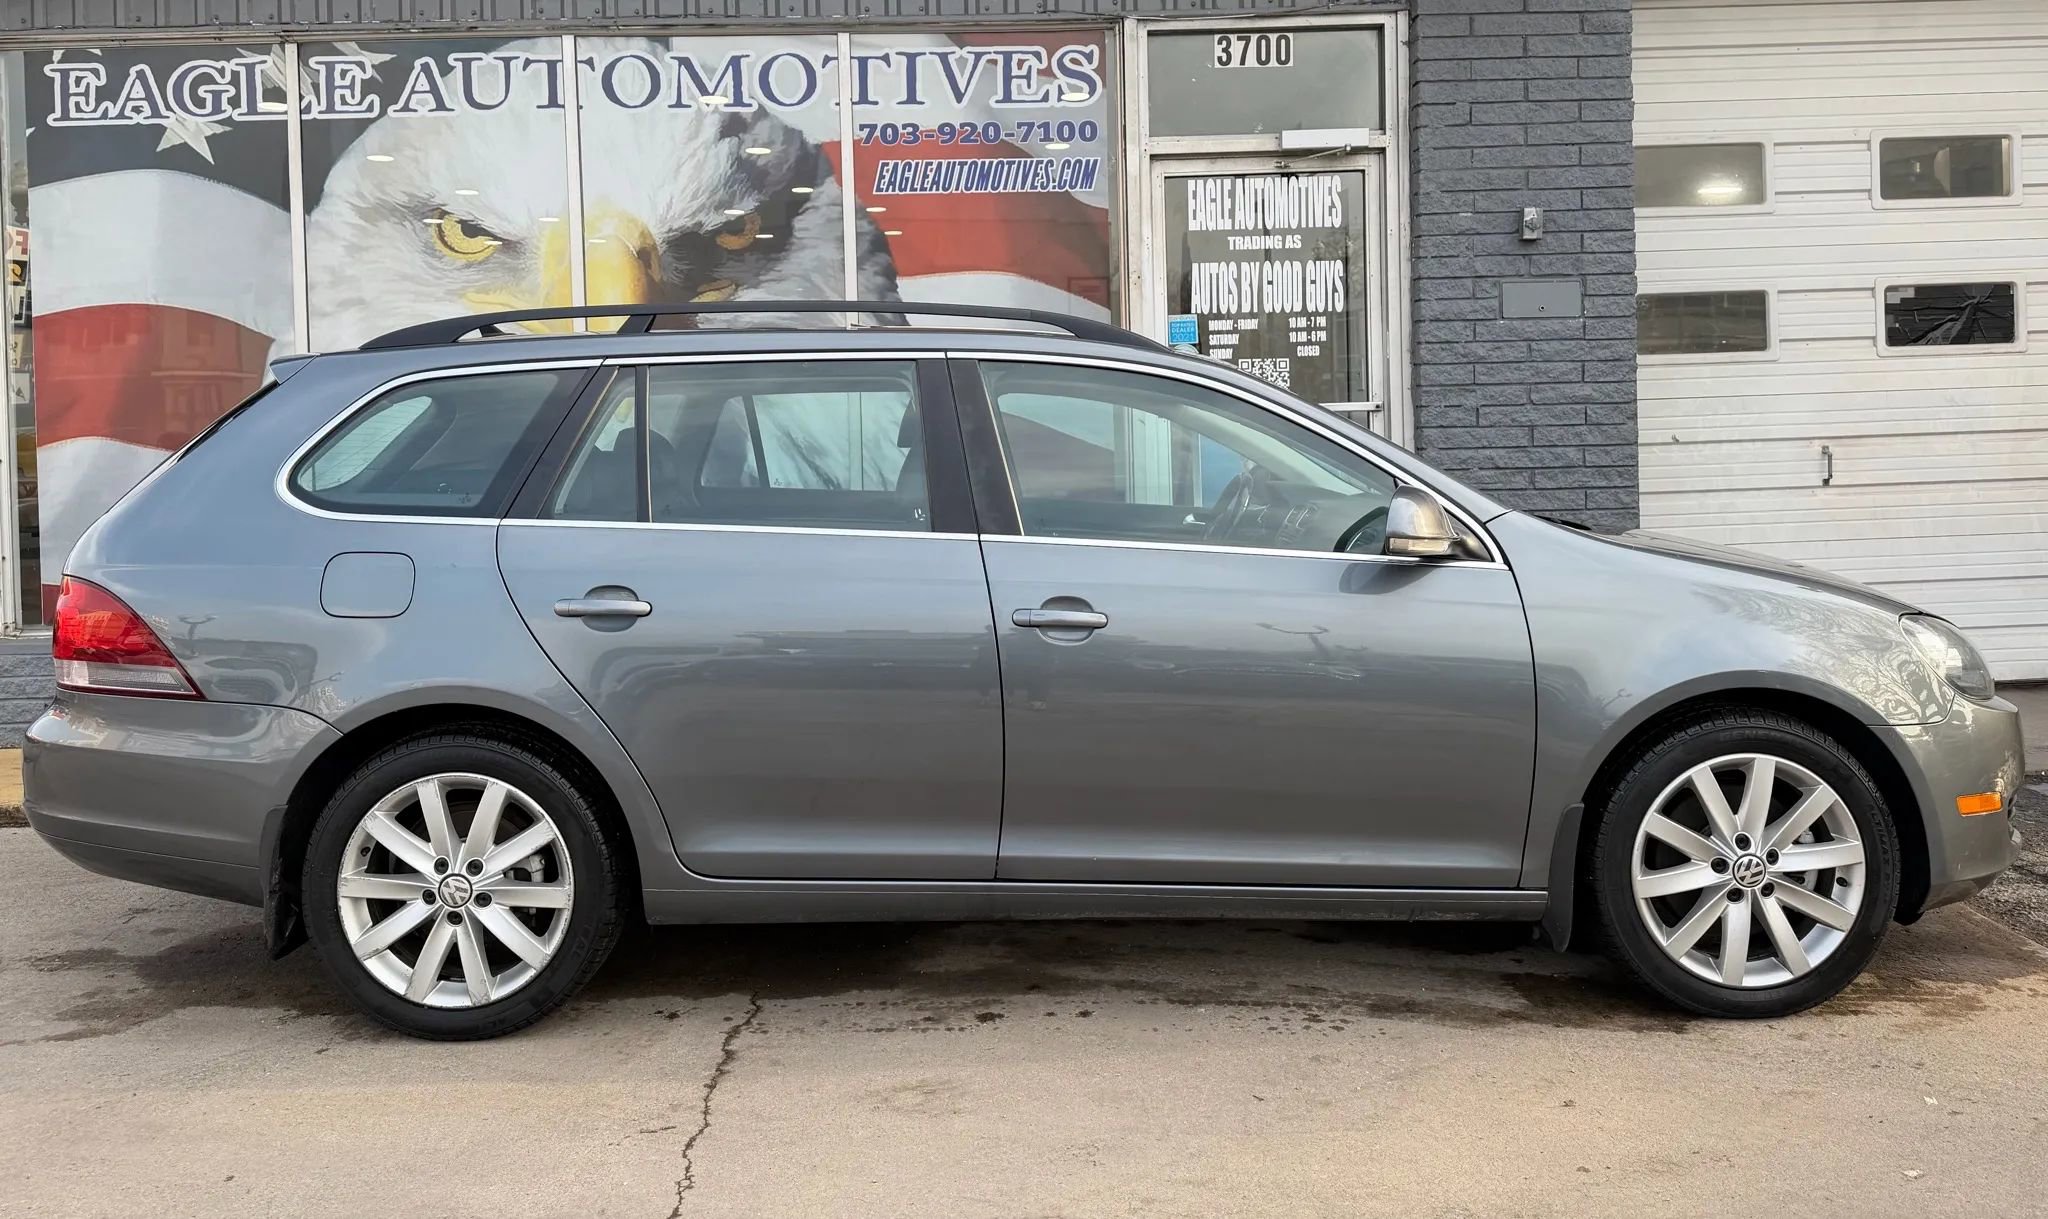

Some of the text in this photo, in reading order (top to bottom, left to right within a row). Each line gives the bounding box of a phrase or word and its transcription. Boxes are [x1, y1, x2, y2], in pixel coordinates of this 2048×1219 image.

[1216, 34, 1291, 67] 3700
[44, 43, 1101, 127] EAGLE AUTOMOTIVES
[858, 120, 1098, 146] 703-920-7100
[873, 157, 1100, 195] EAGLEAUTOMOTIVES.COM
[1187, 175, 1342, 231] EAGLE AUTOMOTIVES
[1227, 234, 1302, 250] TRADING AS
[1191, 259, 1345, 315] AUTOS BY GOOD GUYS
[1208, 319, 1234, 331] MONDAY
[1238, 318, 1258, 330] FRIDAY
[1288, 317, 1296, 328] 10
[1297, 317, 1307, 328] AM
[1311, 316, 1315, 327] 7
[1316, 316, 1327, 327] PM
[1172, 333, 1195, 341] 2021
[1209, 333, 1239, 346] SATURDAY
[1289, 331, 1297, 342] 10
[1297, 331, 1307, 342] AM
[1311, 330, 1316, 342] 6
[1316, 330, 1327, 342] PM
[1209, 348, 1233, 359] SUNDAY
[1297, 345, 1320, 357] CLOSED
